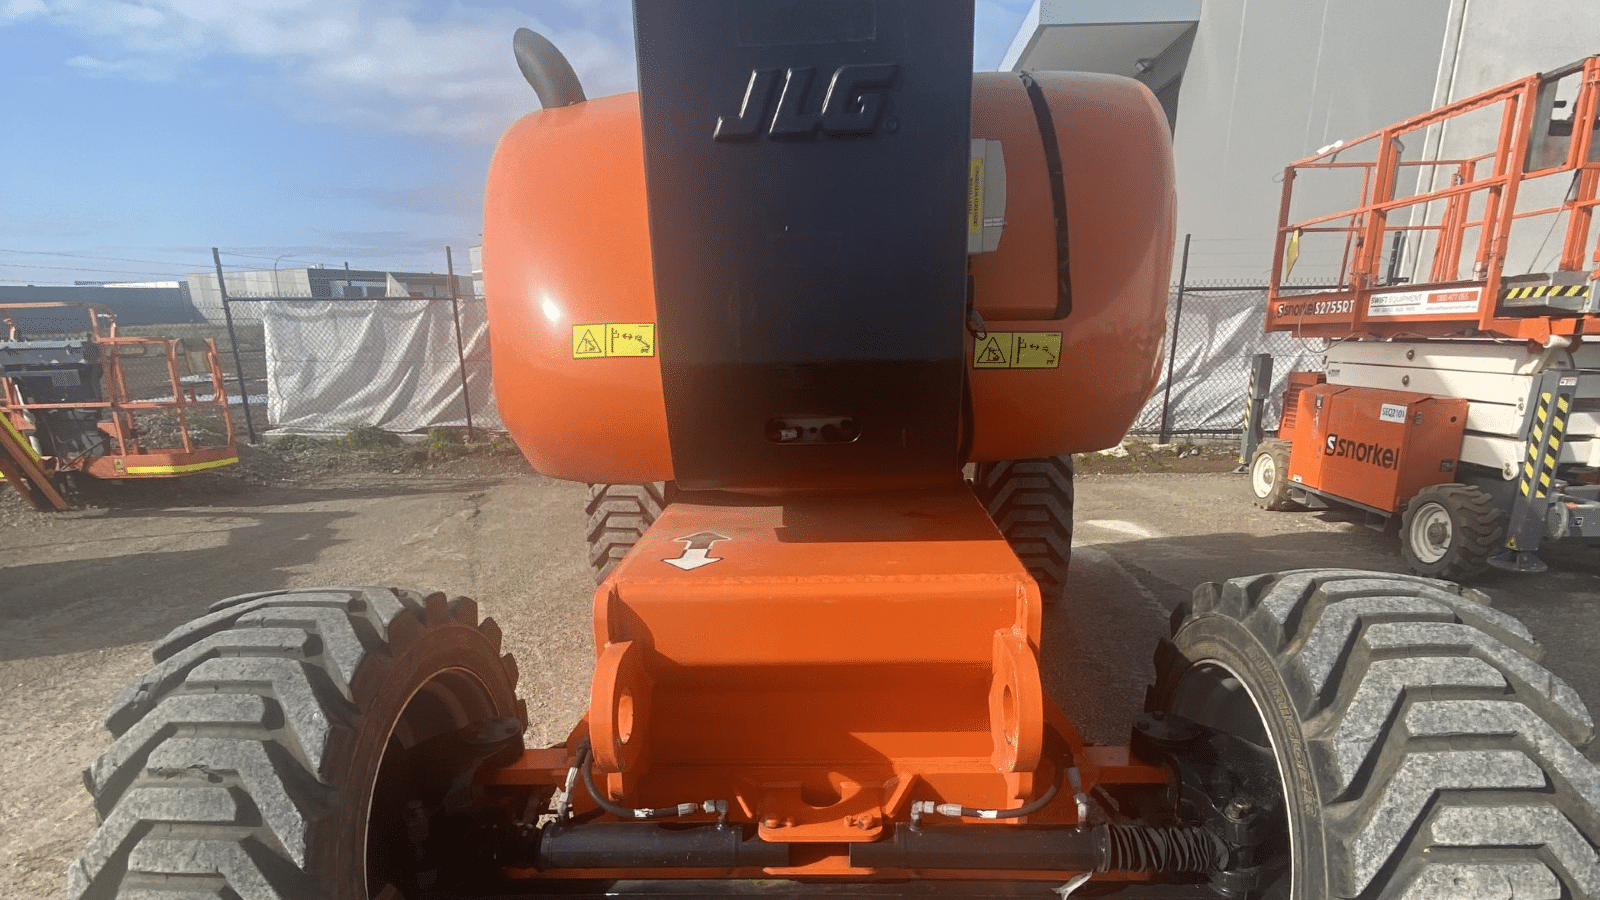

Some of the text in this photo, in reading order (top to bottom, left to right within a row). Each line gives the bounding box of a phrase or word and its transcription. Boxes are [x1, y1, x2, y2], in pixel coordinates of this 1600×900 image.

[713, 65, 899, 143] JLG
[1371, 293, 1422, 304] SWIFT EQUIPMENT
[1315, 299, 1355, 314] S2755RT
[1382, 407, 1405, 418] SEQ2101
[1336, 438, 1400, 471] snorkel
